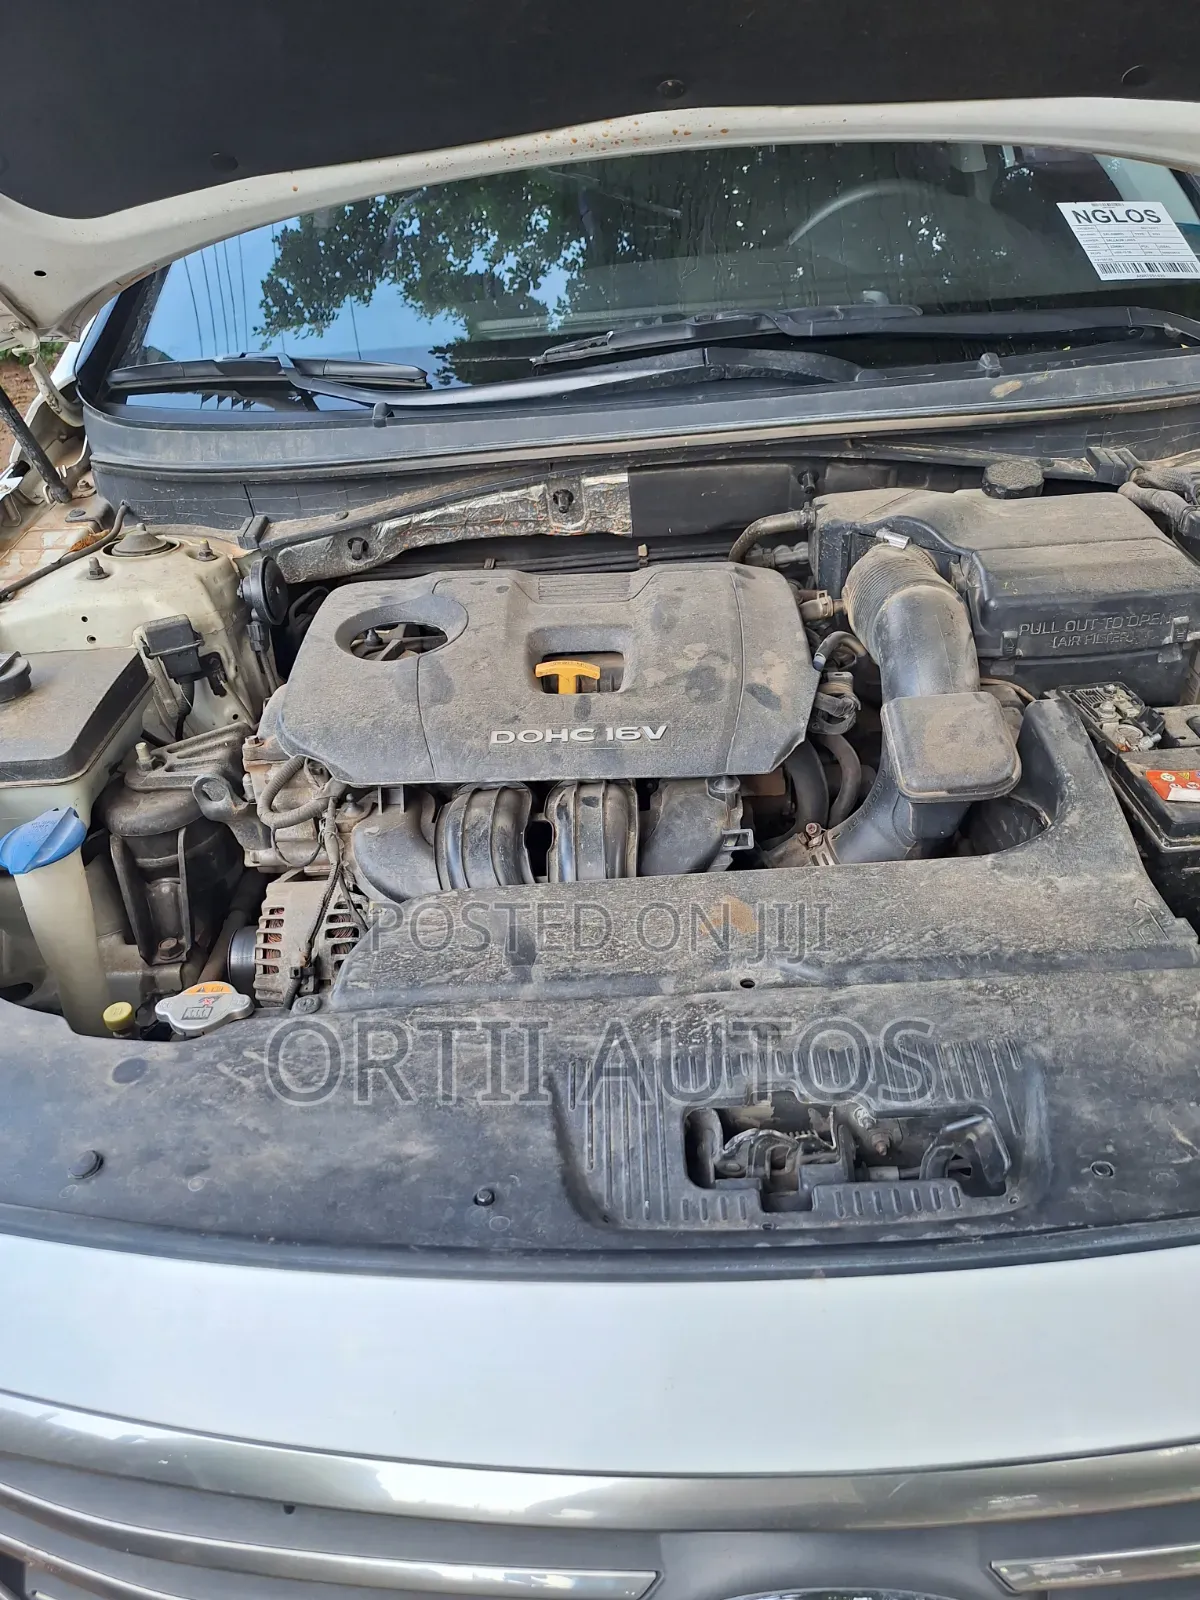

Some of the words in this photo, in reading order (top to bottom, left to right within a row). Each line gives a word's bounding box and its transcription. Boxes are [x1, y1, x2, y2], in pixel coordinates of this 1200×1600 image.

[1071, 209, 1162, 224] NGLOS
[1019, 622, 1060, 636] PULL
[1064, 618, 1099, 633] OUT
[1103, 616, 1125, 630] TO
[1126, 612, 1174, 628] OPEN
[490, 728, 596, 744] DOHC
[605, 725, 668, 742] 16V
